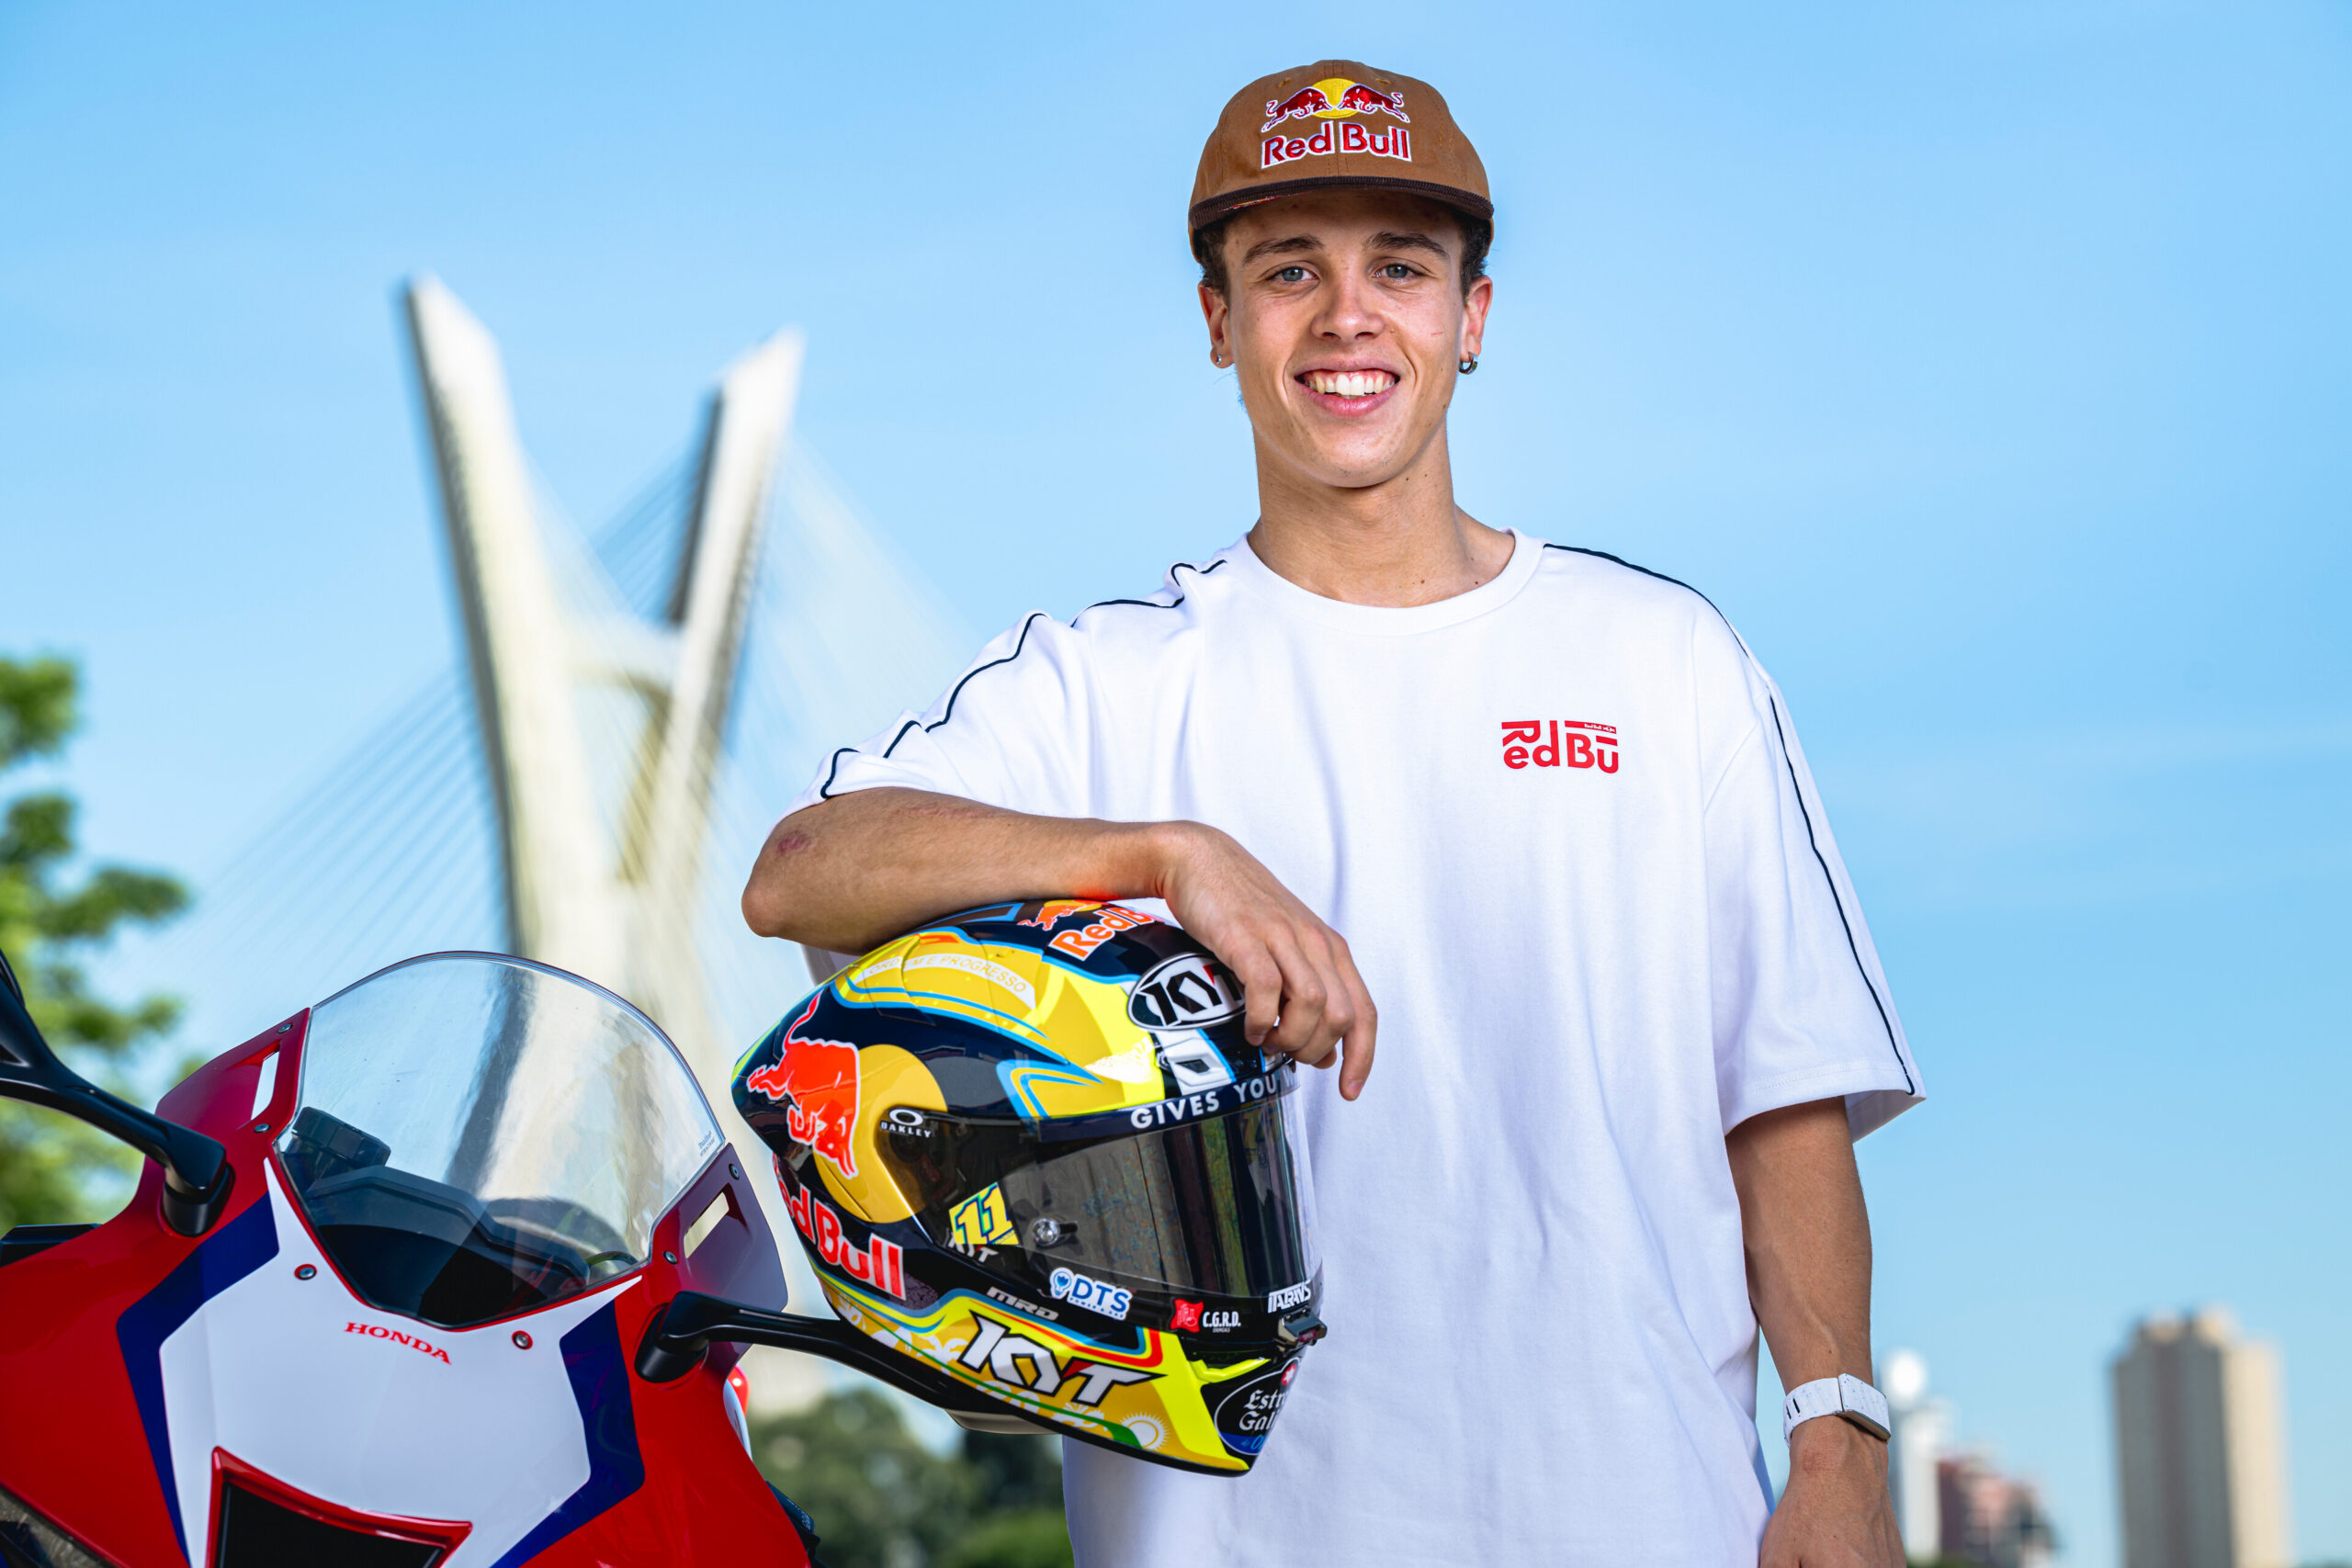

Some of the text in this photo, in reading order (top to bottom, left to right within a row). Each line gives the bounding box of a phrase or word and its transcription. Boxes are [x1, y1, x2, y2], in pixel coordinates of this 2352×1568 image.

[1262, 122, 1410, 167] Red Bull
[1047, 909, 1137, 961] Red
[940, 954, 1026, 993] PROGRESSO
[1130, 1090, 1220, 1129] GIVES
[1233, 1074, 1276, 1103] YOU
[879, 1121, 932, 1138] OAKLEY
[814, 1199, 906, 1301] Bull
[1072, 1278, 1128, 1313] DTS
[1203, 1311, 1241, 1327] C.G.R.D.
[344, 1322, 452, 1366] HONDA
[957, 1310, 1168, 1407] KYT
